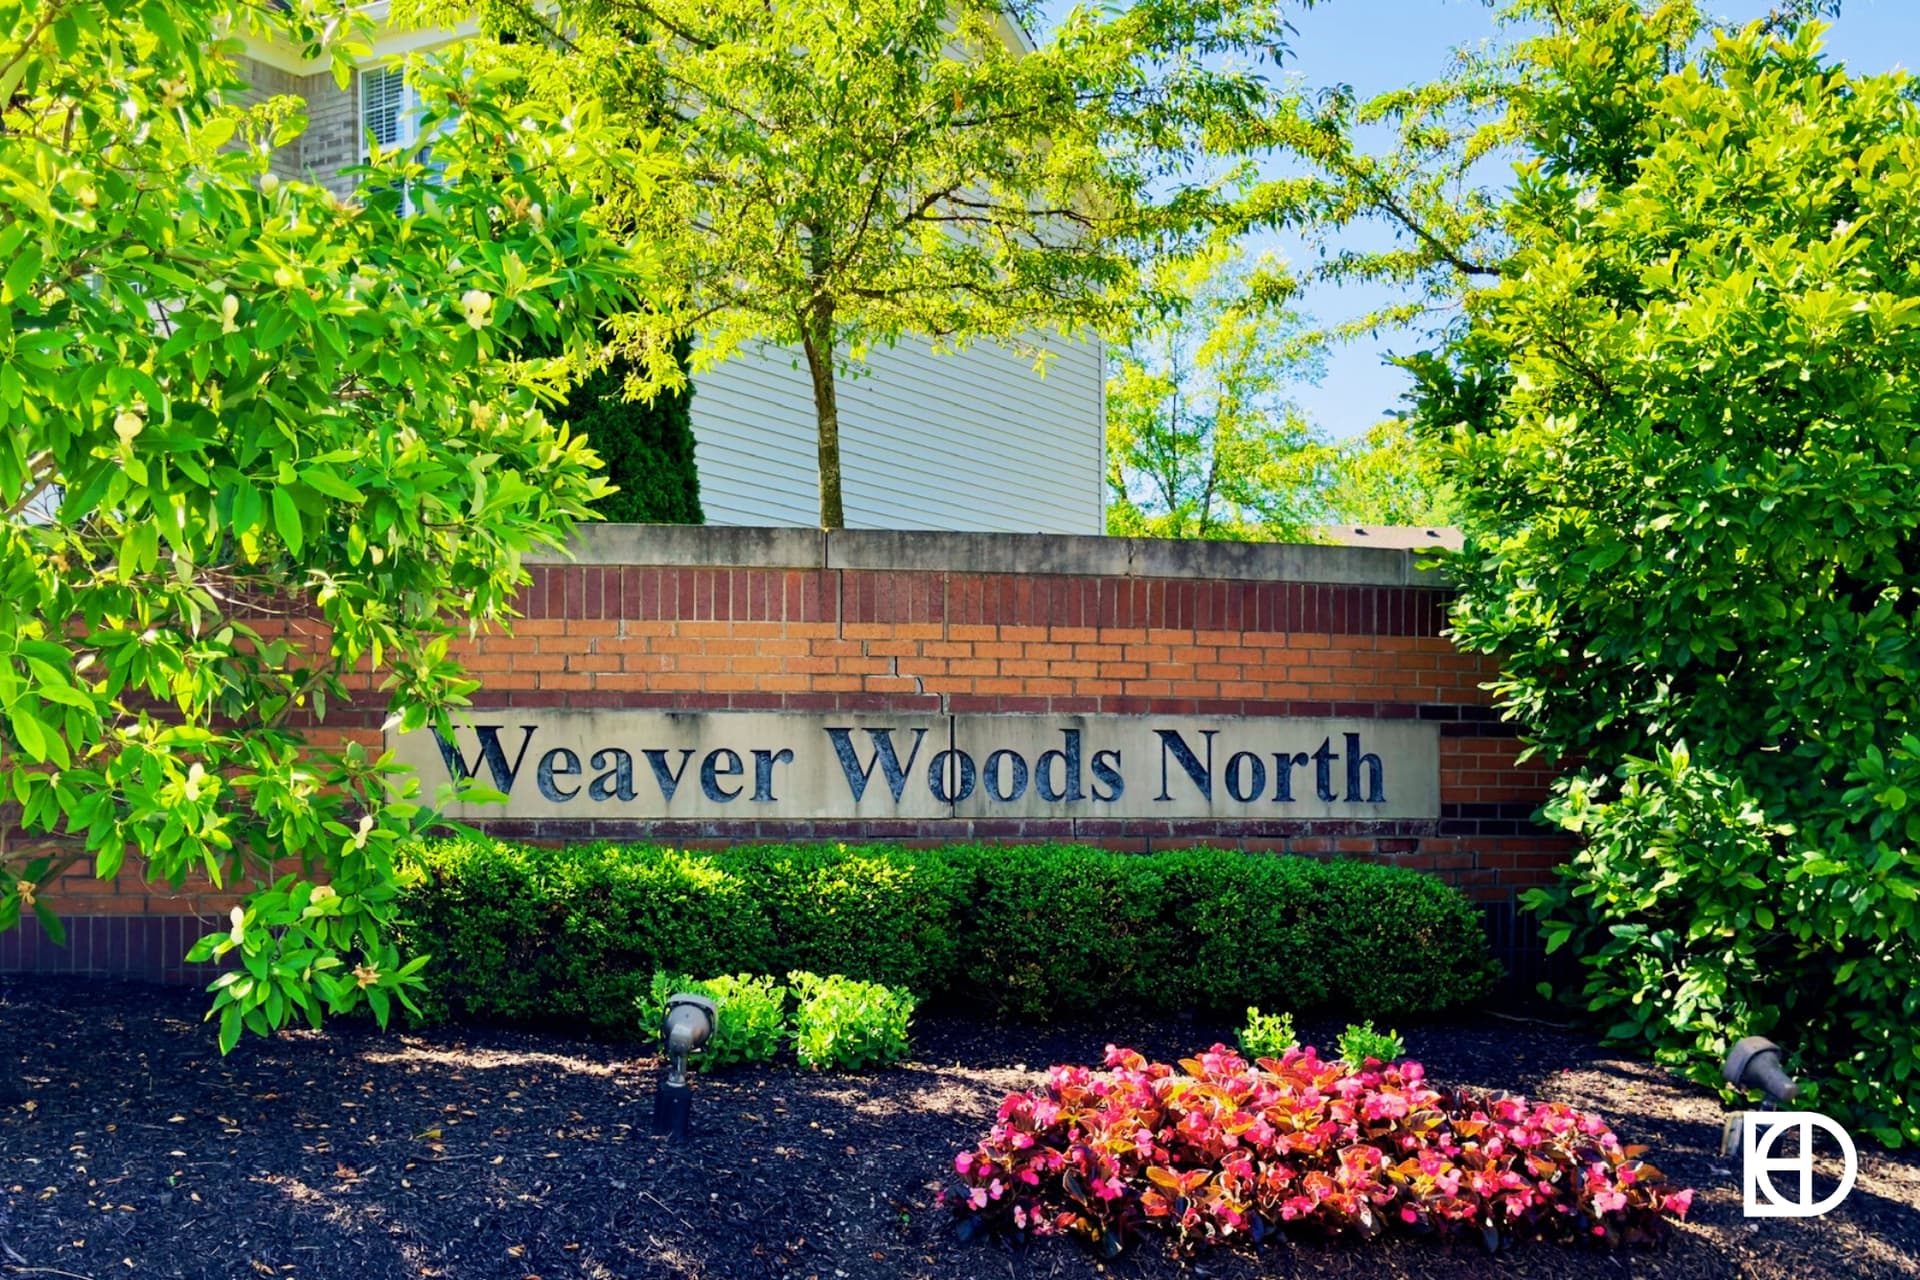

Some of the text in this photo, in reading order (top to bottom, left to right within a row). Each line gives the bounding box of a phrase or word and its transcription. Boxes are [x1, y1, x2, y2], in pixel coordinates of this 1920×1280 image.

[427, 724, 1388, 804] Weaver Woods North
